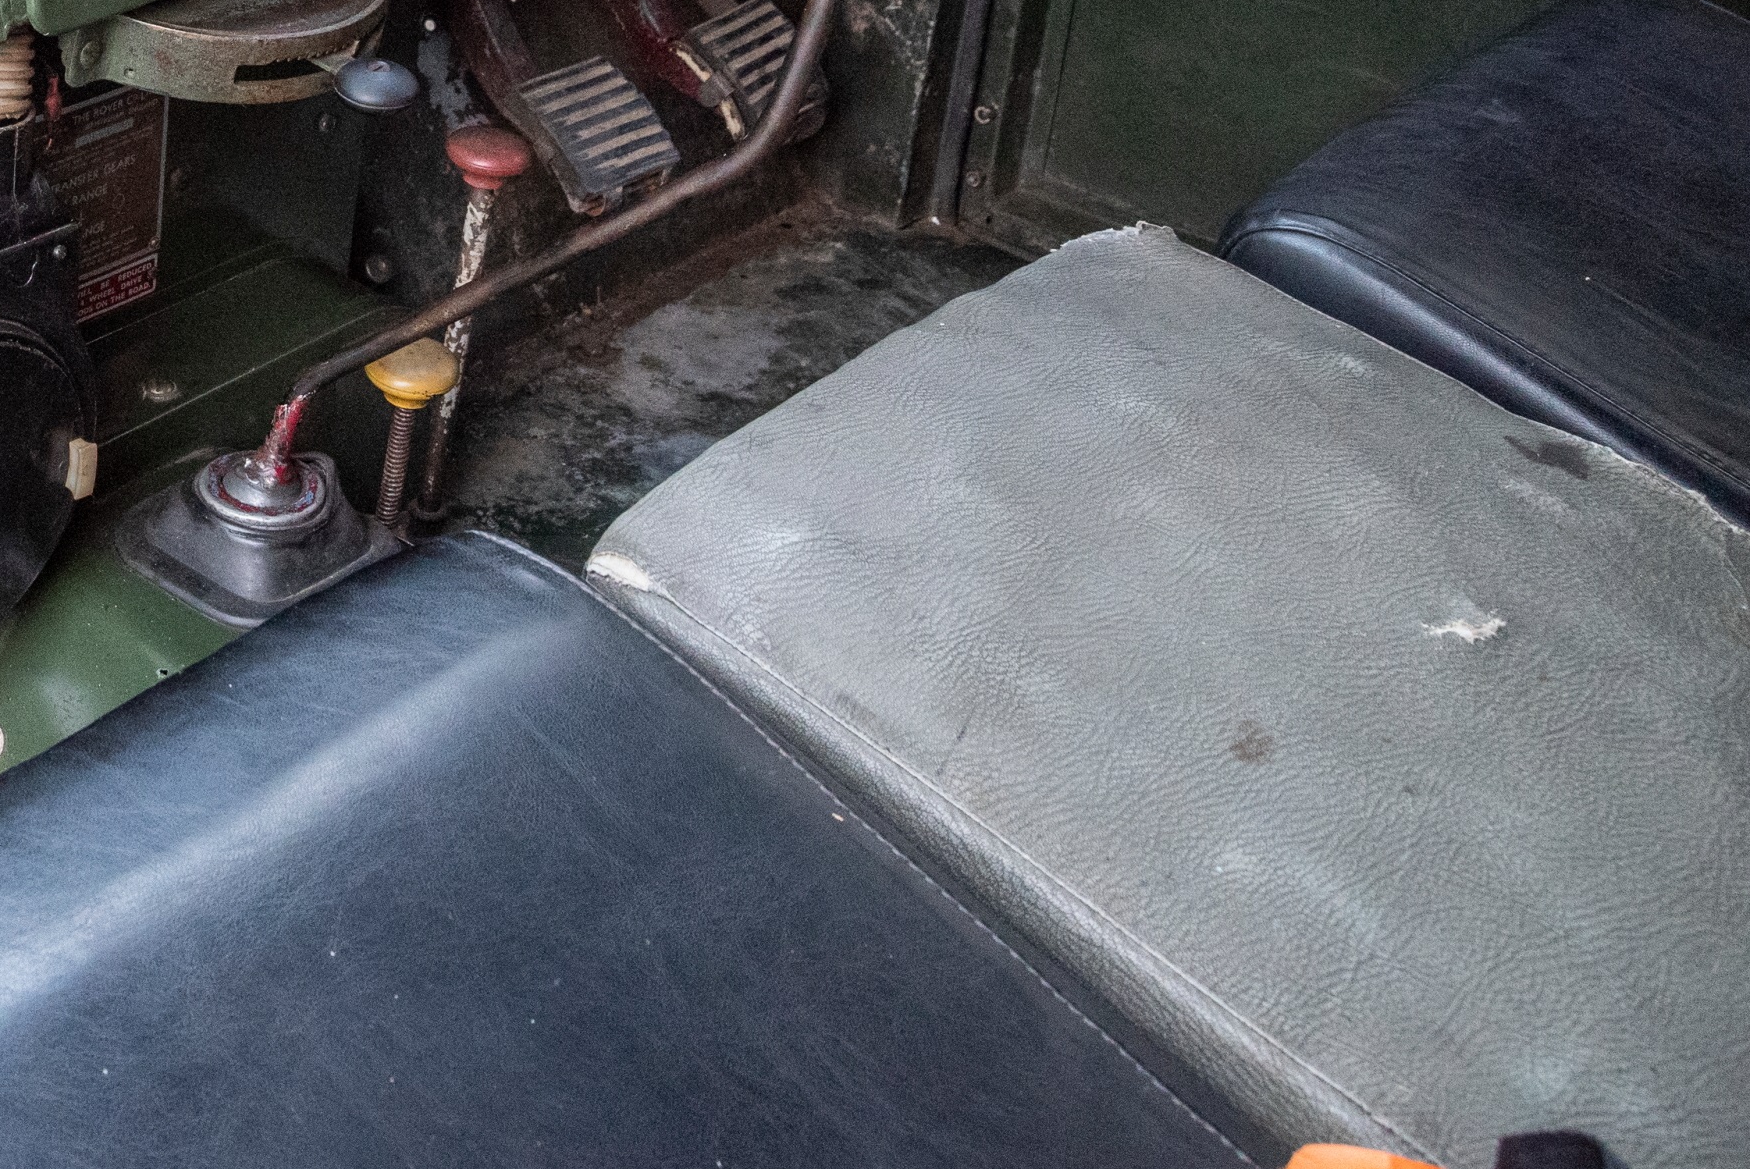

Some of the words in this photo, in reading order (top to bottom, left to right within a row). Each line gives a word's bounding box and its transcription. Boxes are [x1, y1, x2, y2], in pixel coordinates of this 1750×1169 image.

[72, 110, 91, 125] THE
[93, 98, 124, 117] ROVER
[103, 154, 137, 176] GEARS
[71, 182, 109, 206] RANGE
[100, 279, 111, 290] BE
[117, 262, 153, 282] REDUCED
[89, 288, 117, 303] WHEEL
[120, 275, 144, 291] DRIVE
[95, 299, 109, 310] ON
[110, 291, 127, 304] THE
